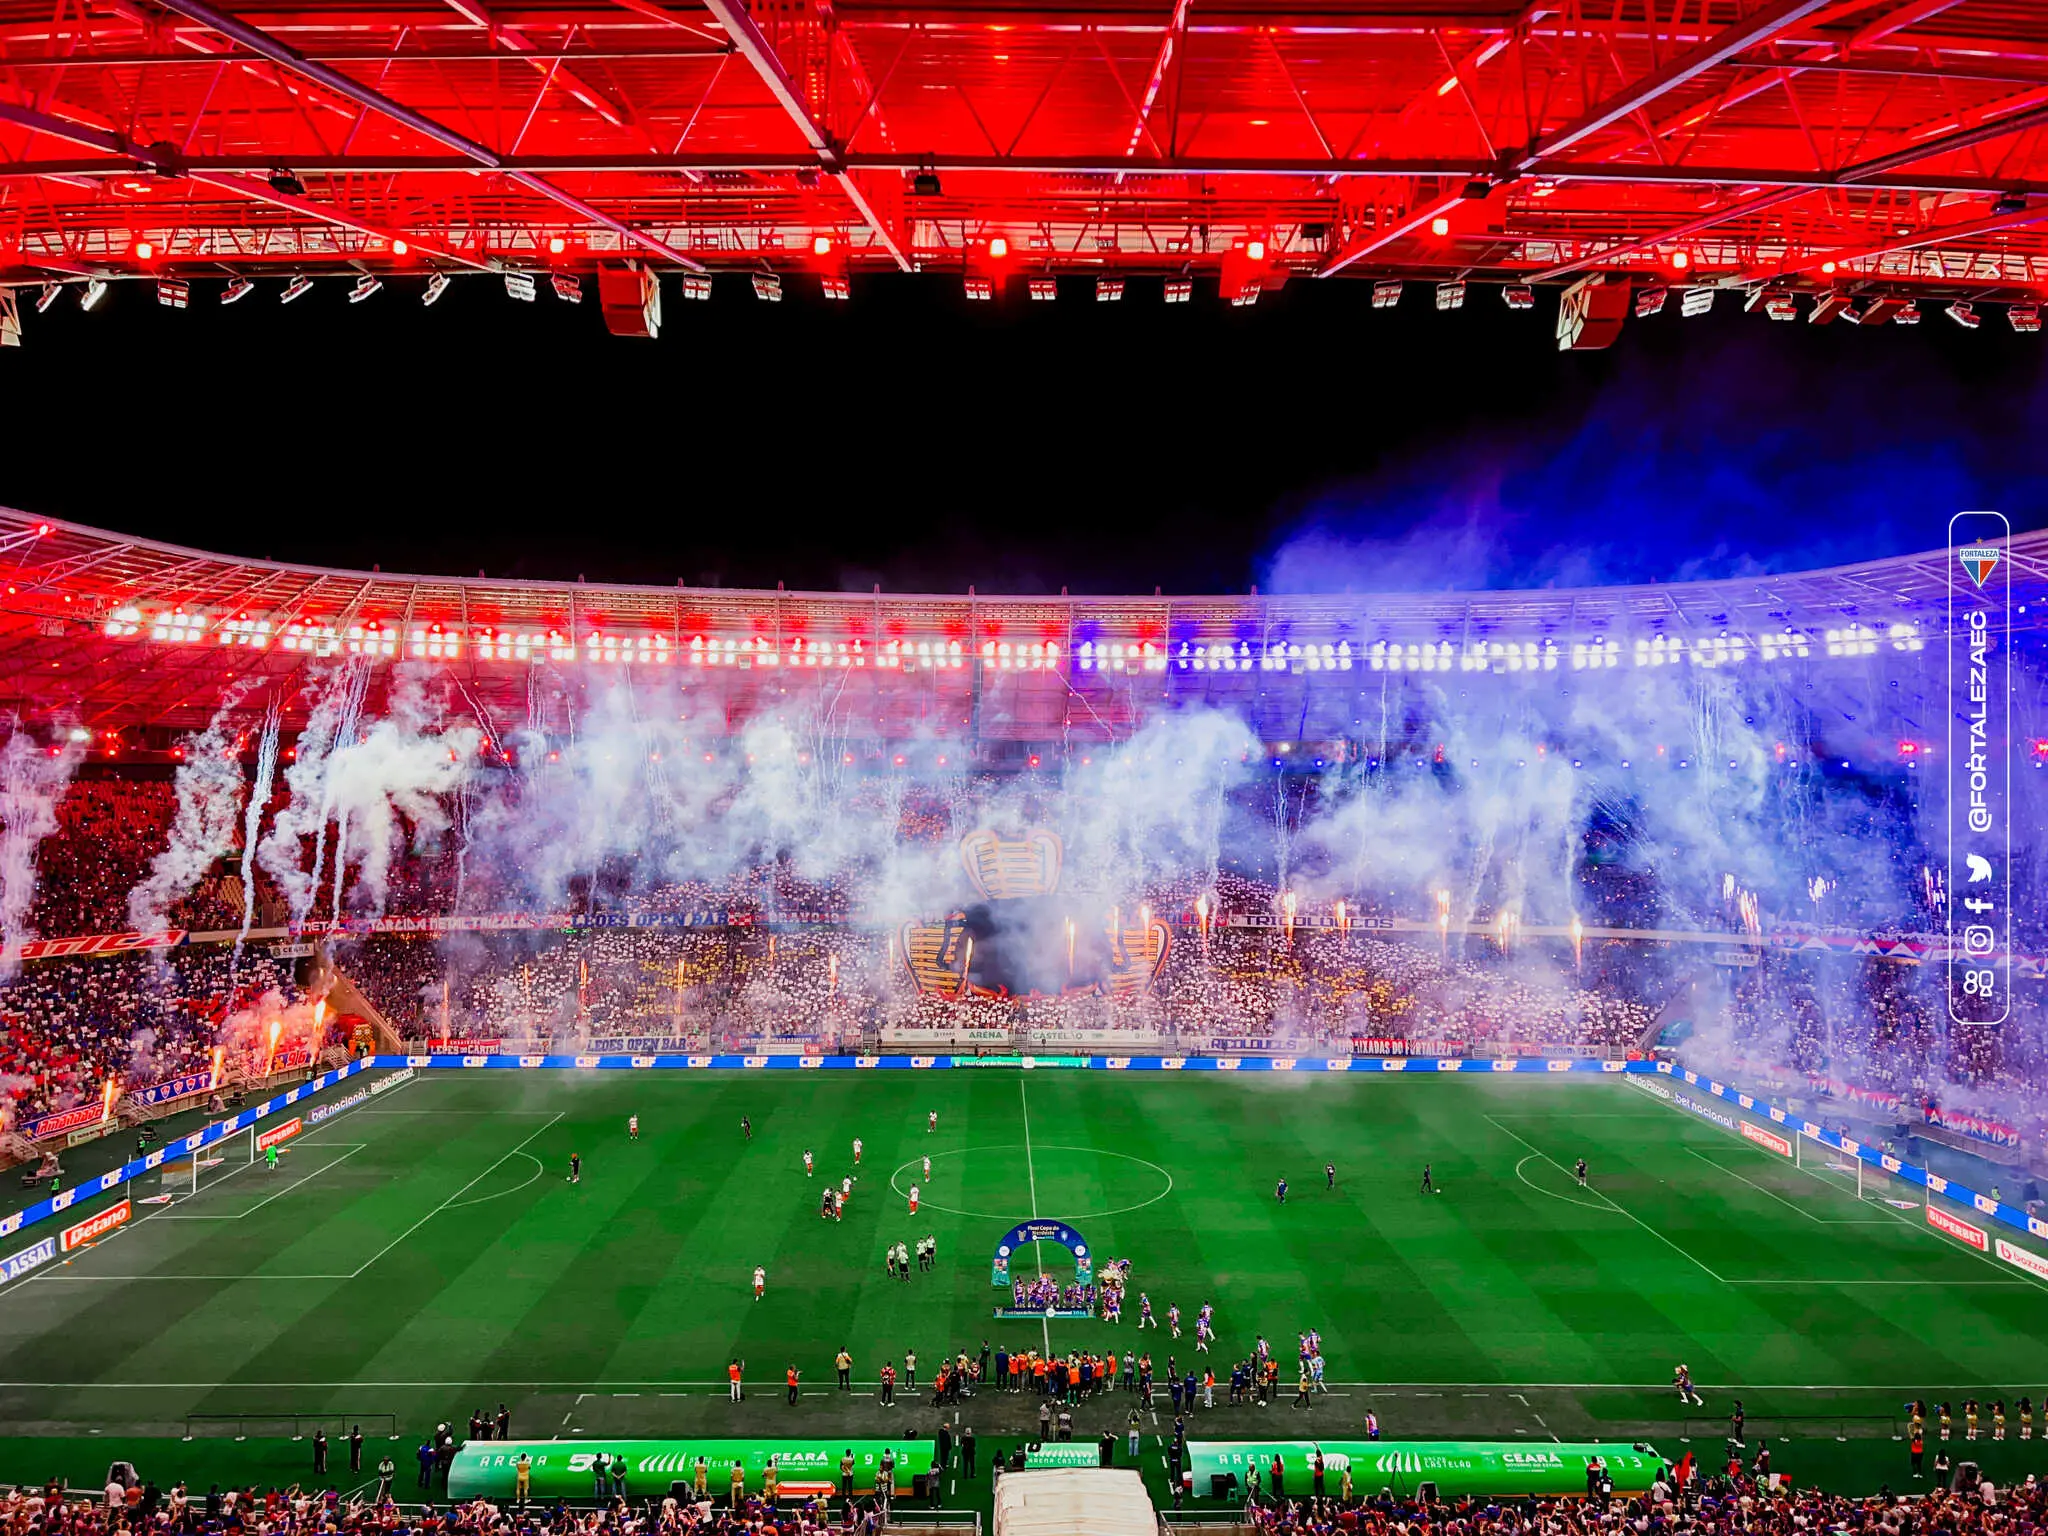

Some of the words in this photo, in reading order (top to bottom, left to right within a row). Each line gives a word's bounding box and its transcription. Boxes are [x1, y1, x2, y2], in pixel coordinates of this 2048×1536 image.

[636, 910, 686, 926] OPEN
[690, 910, 728, 926] BAR
[968, 1031, 1003, 1039] ARENA
[627, 1038, 658, 1051] OPEN
[661, 1037, 687, 1051] BAR
[1391, 1040, 1403, 1055] DO
[407, 1055, 431, 1068] CBF
[463, 1055, 487, 1068] CBF
[520, 1055, 544, 1068] CBF
[575, 1055, 599, 1068] CBF
[632, 1055, 656, 1068] CBF
[688, 1055, 712, 1068] CBF
[744, 1055, 768, 1068] CBF
[800, 1055, 824, 1068] CBF
[856, 1055, 880, 1068] CBF
[911, 1055, 935, 1068] CBF
[1107, 1057, 1131, 1069] CBF
[1162, 1057, 1186, 1069] CBF
[1217, 1057, 1241, 1069] CBF
[1272, 1058, 1296, 1070] CBF
[1327, 1058, 1351, 1070] CBF
[1383, 1058, 1407, 1070] CBF
[1438, 1059, 1462, 1071] CBF
[1493, 1059, 1517, 1071] CBF
[1547, 1059, 1571, 1071] CBF
[1603, 1059, 1627, 1071] CBF
[1743, 1124, 1786, 1152] Betano
[145, 1148, 165, 1170] CBF
[1881, 1154, 1903, 1174] CBF
[101, 1167, 123, 1190] CBF
[1927, 1173, 1949, 1194] CBF
[52, 1188, 76, 1213] CBF
[1974, 1193, 1999, 1216] CBF
[0, 1211, 24, 1238] CBF
[70, 1207, 127, 1246] Betano
[1929, 1210, 1982, 1244] SUPERBET
[770, 1450, 829, 1462] CEARÁ
[1502, 1451, 1562, 1463] CEARÁ
